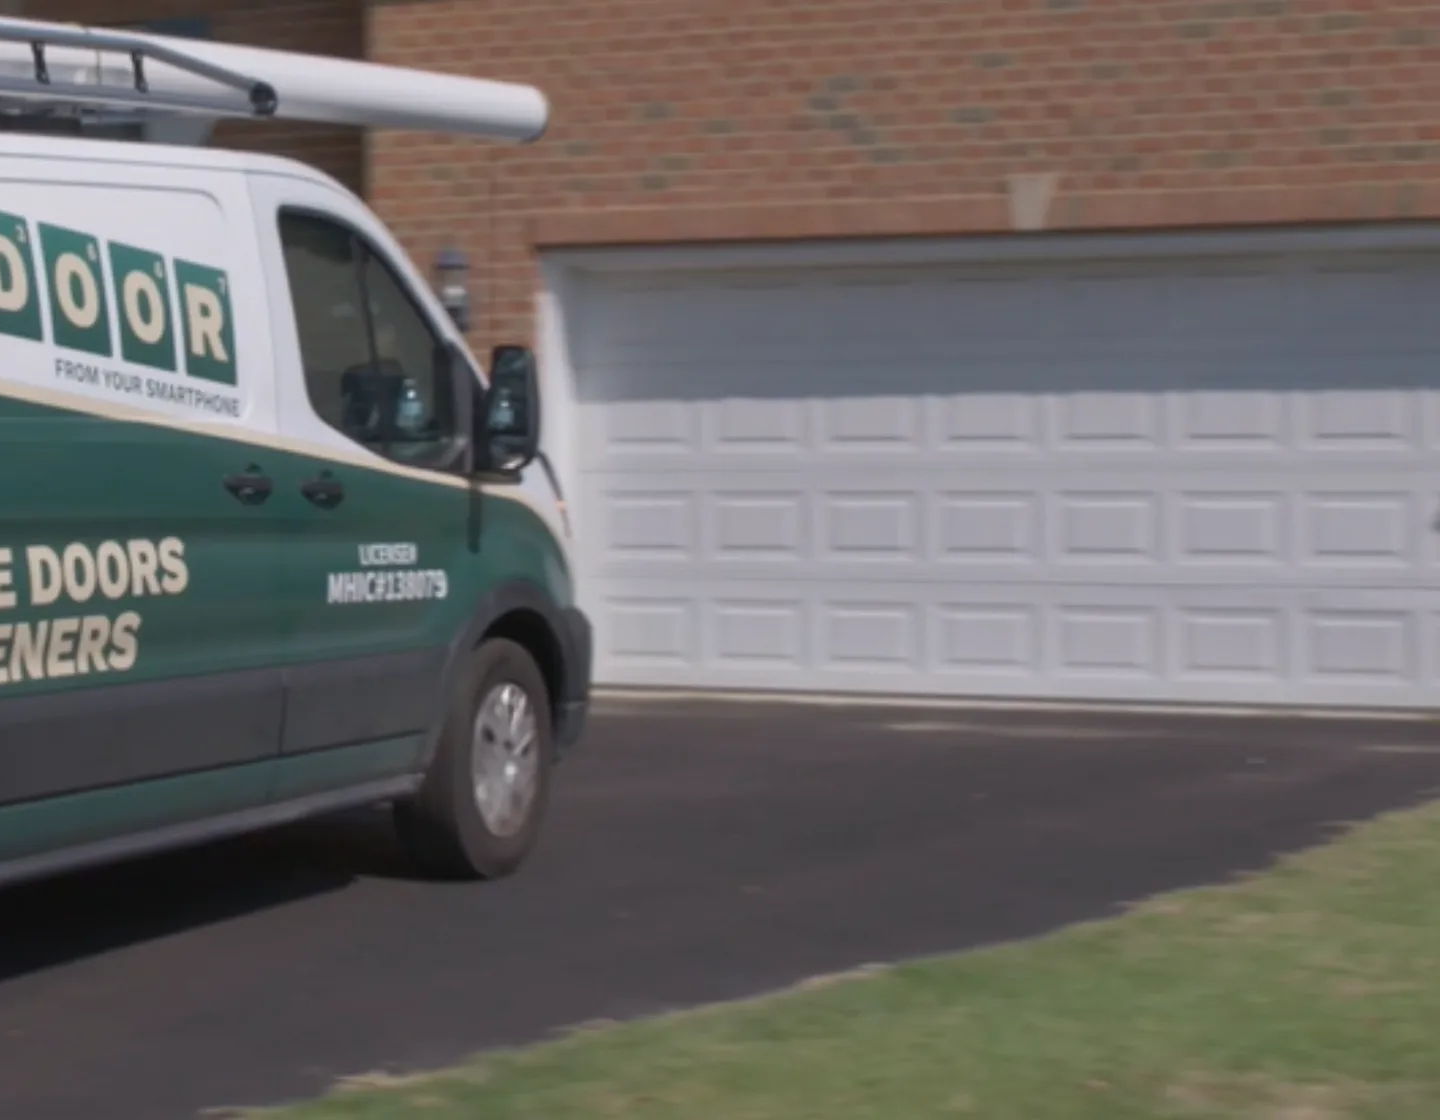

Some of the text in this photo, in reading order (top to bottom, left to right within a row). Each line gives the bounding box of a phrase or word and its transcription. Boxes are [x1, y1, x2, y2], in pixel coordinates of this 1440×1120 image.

[55, 357, 241, 418] FROM YOUR SMARTPHONE
[26, 536, 189, 606] DOORS
